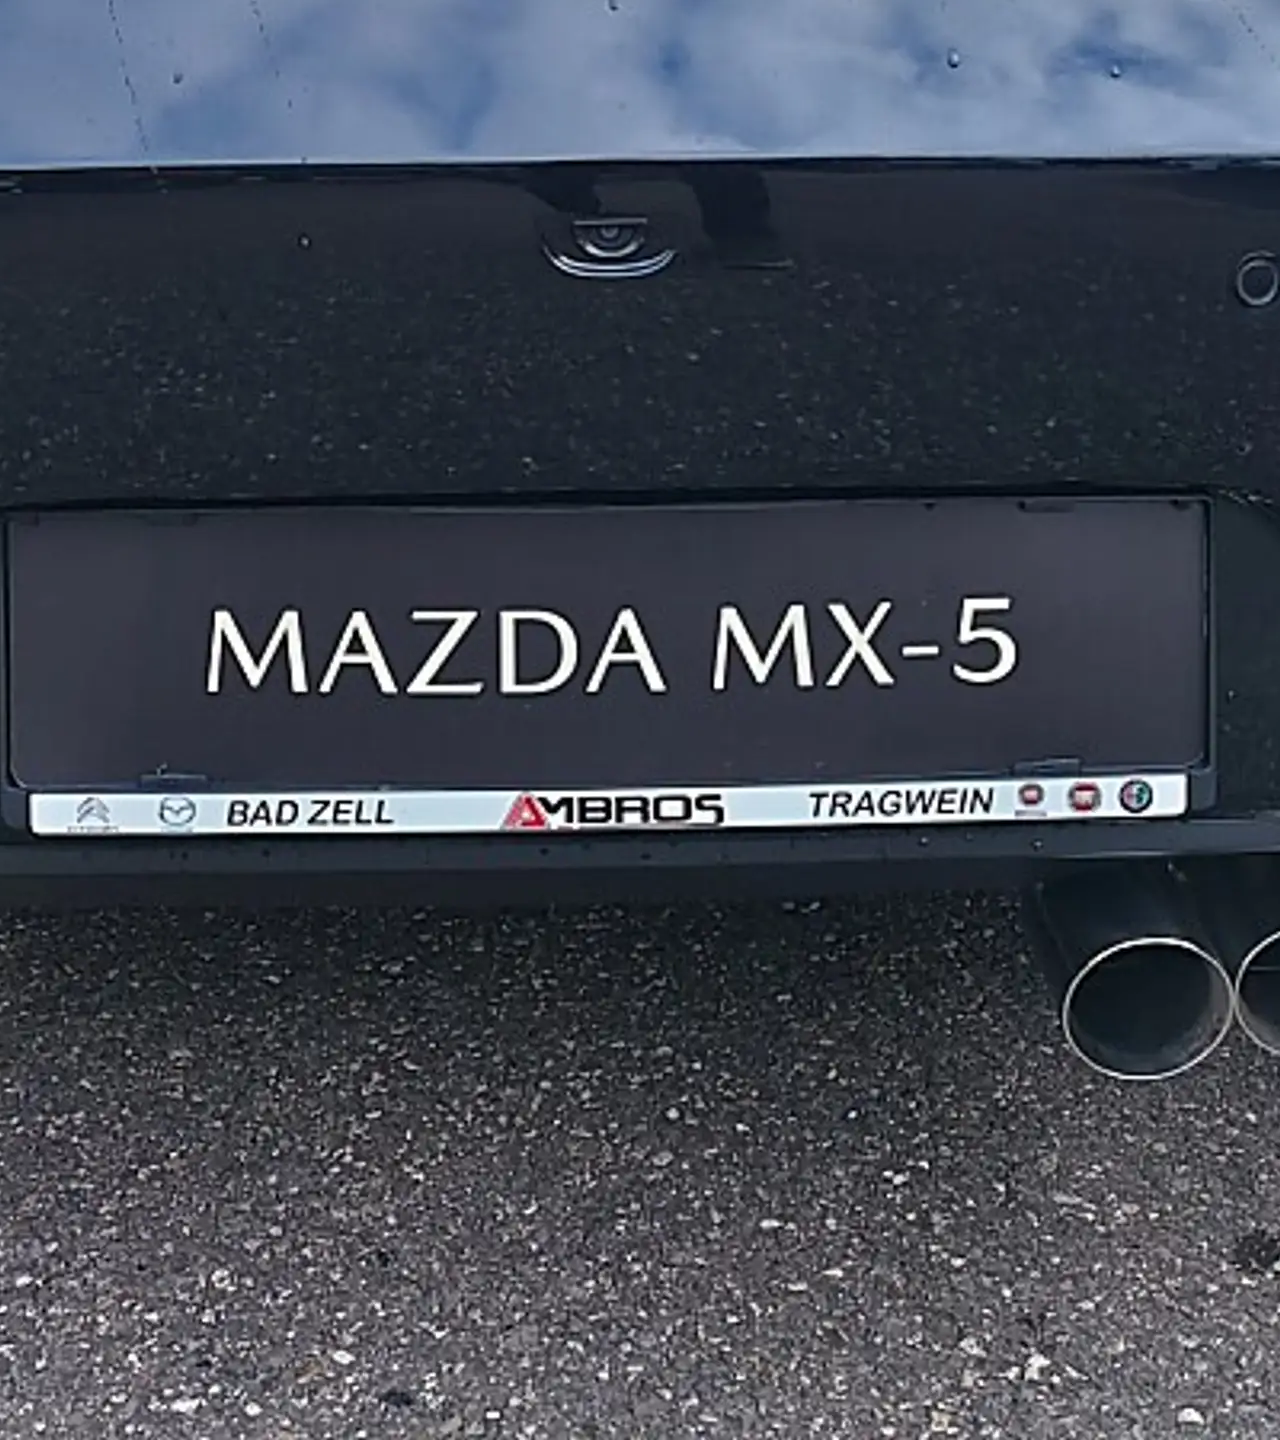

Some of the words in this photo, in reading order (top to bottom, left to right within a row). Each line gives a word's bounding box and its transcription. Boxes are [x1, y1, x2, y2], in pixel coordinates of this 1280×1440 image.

[206, 608, 667, 695] MAZDA
[713, 597, 1019, 690] MX-5
[227, 800, 299, 827] BAD
[307, 799, 395, 826] ZELL
[501, 791, 725, 830] AMBROS
[809, 787, 994, 818] TRAGWEIN
